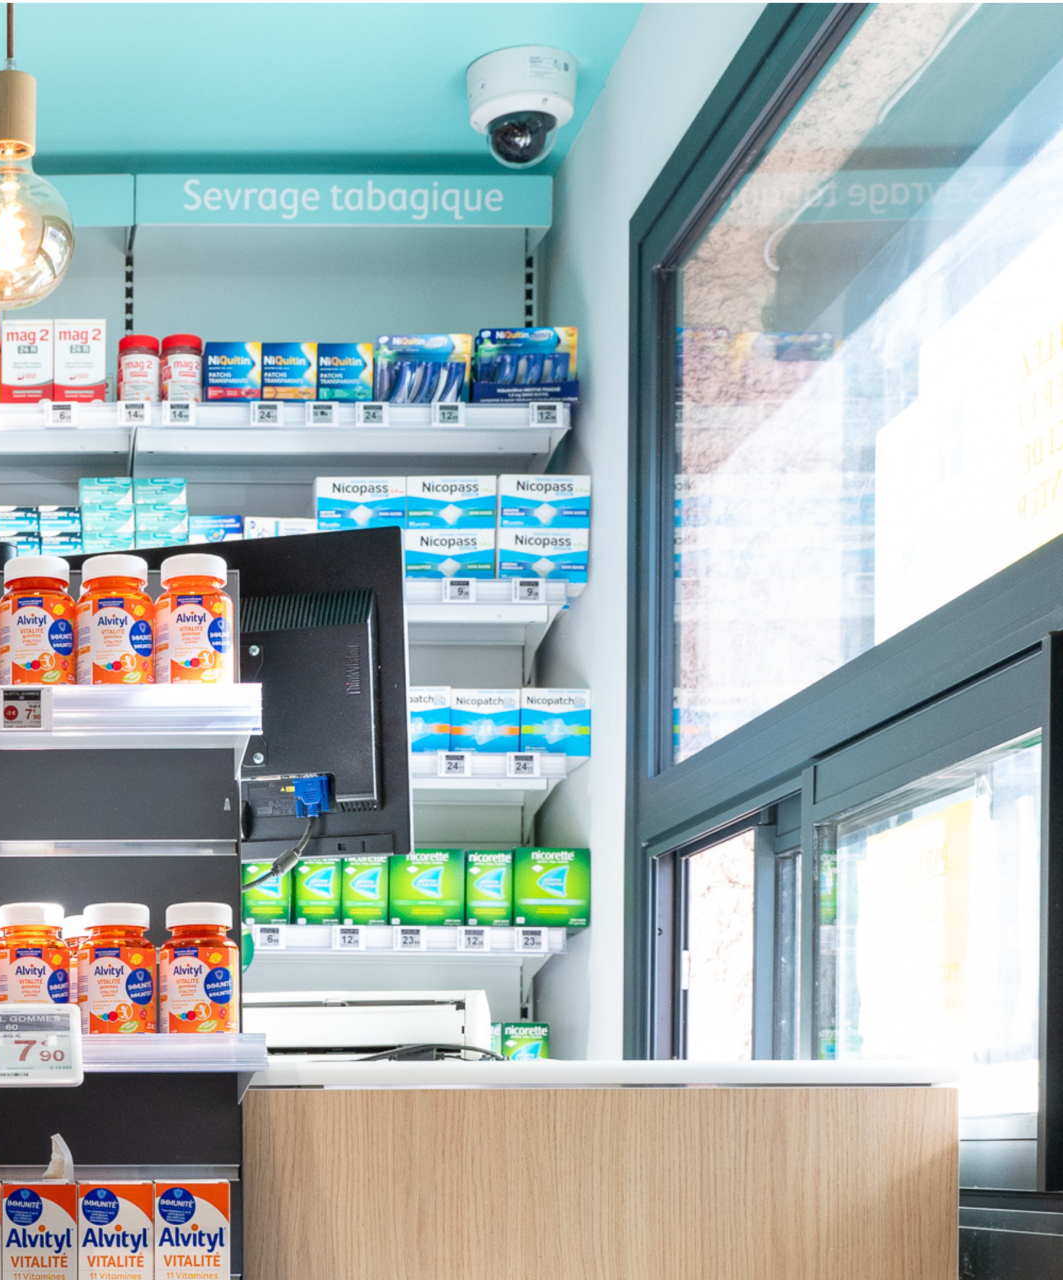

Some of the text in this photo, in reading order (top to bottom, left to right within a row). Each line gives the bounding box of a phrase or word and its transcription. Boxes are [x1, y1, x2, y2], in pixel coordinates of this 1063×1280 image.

[182, 179, 505, 220] Sevrage tabagique
[5, 329, 50, 345] mag 2
[58, 329, 102, 345] mag 2
[495, 330, 530, 339] NiQuitin
[207, 355, 251, 365] NiQuitin
[263, 355, 307, 365] NiQuitin
[319, 356, 363, 366] NiQuitin
[332, 482, 389, 495] Nicopass
[421, 481, 479, 495] Nicopass
[516, 480, 573, 494] Nicopass
[420, 535, 477, 549] Nicopass
[514, 534, 572, 548] Nicopass
[17, 612, 48, 628] Alvityl
[97, 613, 128, 628] Alvityl
[176, 611, 207, 625] Alvityl
[406, 851, 450, 862] nicorette
[468, 852, 513, 863] nicorette
[531, 850, 575, 861] nicorette
[14, 964, 47, 979] Alvityl
[93, 963, 125, 979] Alvityl
[172, 963, 203, 978] Alvityl
[9, 1015, 61, 1023] GOMMES
[505, 1026, 549, 1037] nicorette
[5, 1224, 73, 1254] Alvityl
[81, 1223, 149, 1254] Alvityl
[158, 1223, 226, 1254] Alvityl
[10, 1252, 69, 1268] VITALITÉ
[86, 1252, 145, 1268] VITALITÉ
[163, 1251, 222, 1268] VITALITÉ
